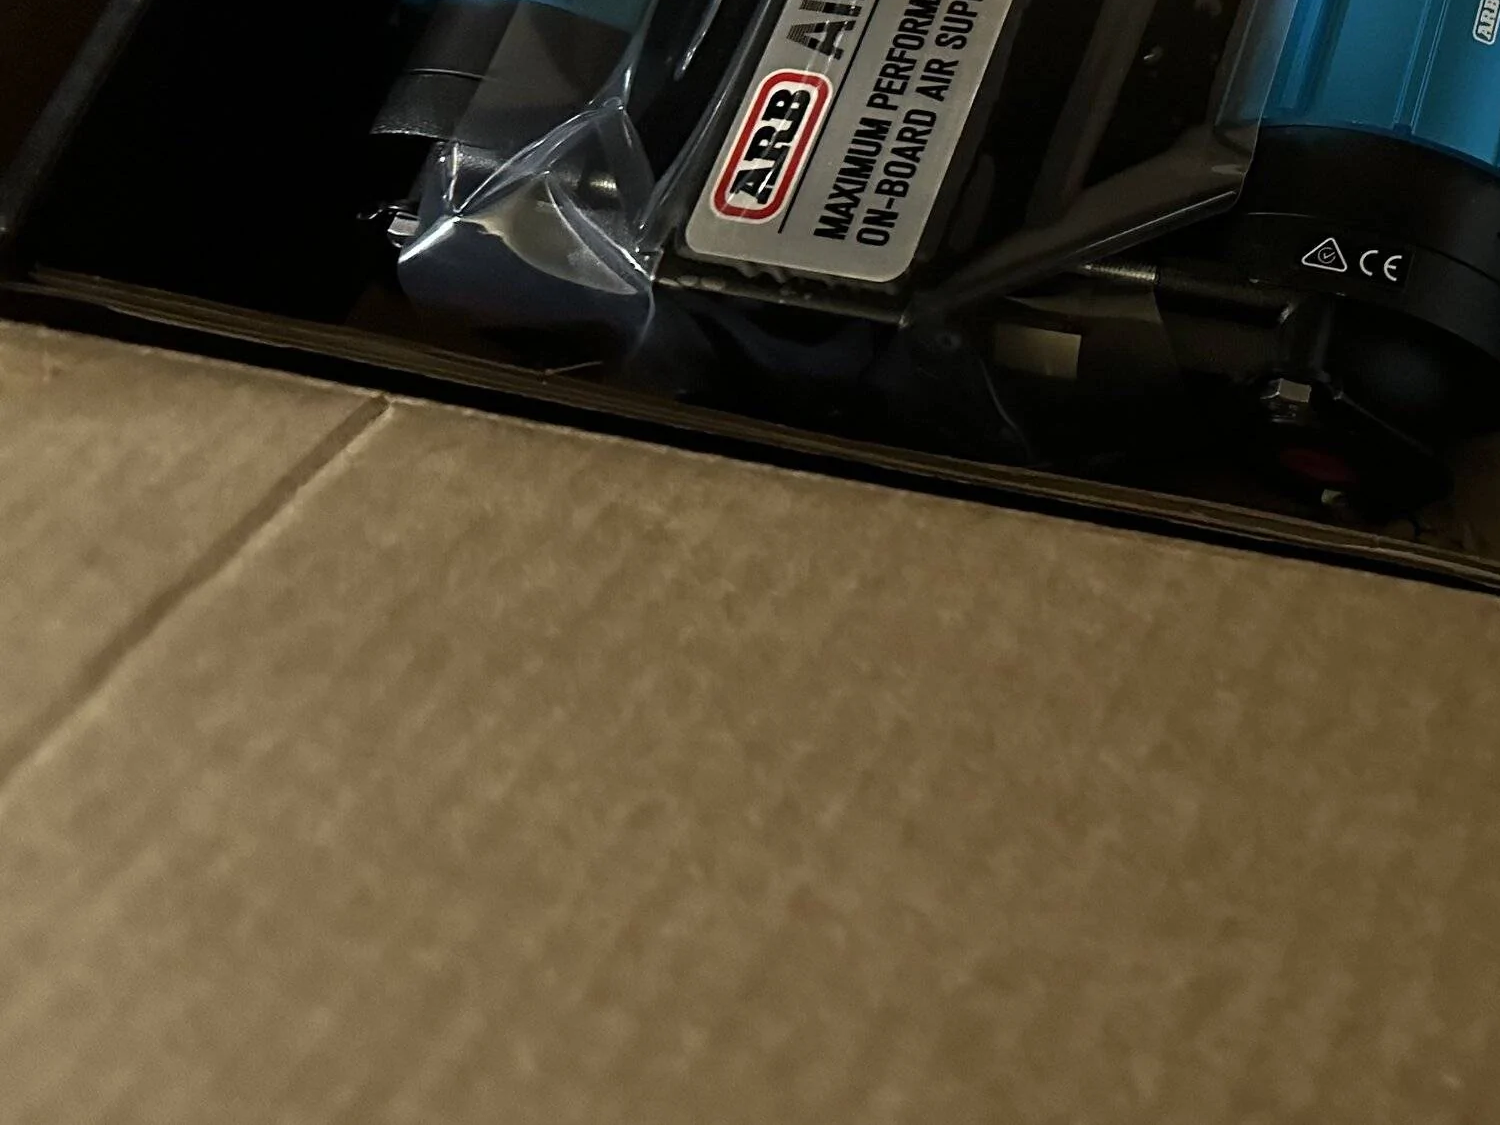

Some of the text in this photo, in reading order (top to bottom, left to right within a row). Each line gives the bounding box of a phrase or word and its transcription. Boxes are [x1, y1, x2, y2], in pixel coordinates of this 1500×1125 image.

[729, 88, 811, 205] ARB
[813, 117, 892, 241] MAXIMUM
[856, 108, 937, 247] ON-BOARD
[915, 58, 959, 102] AIR
[1359, 249, 1403, 281] CE
